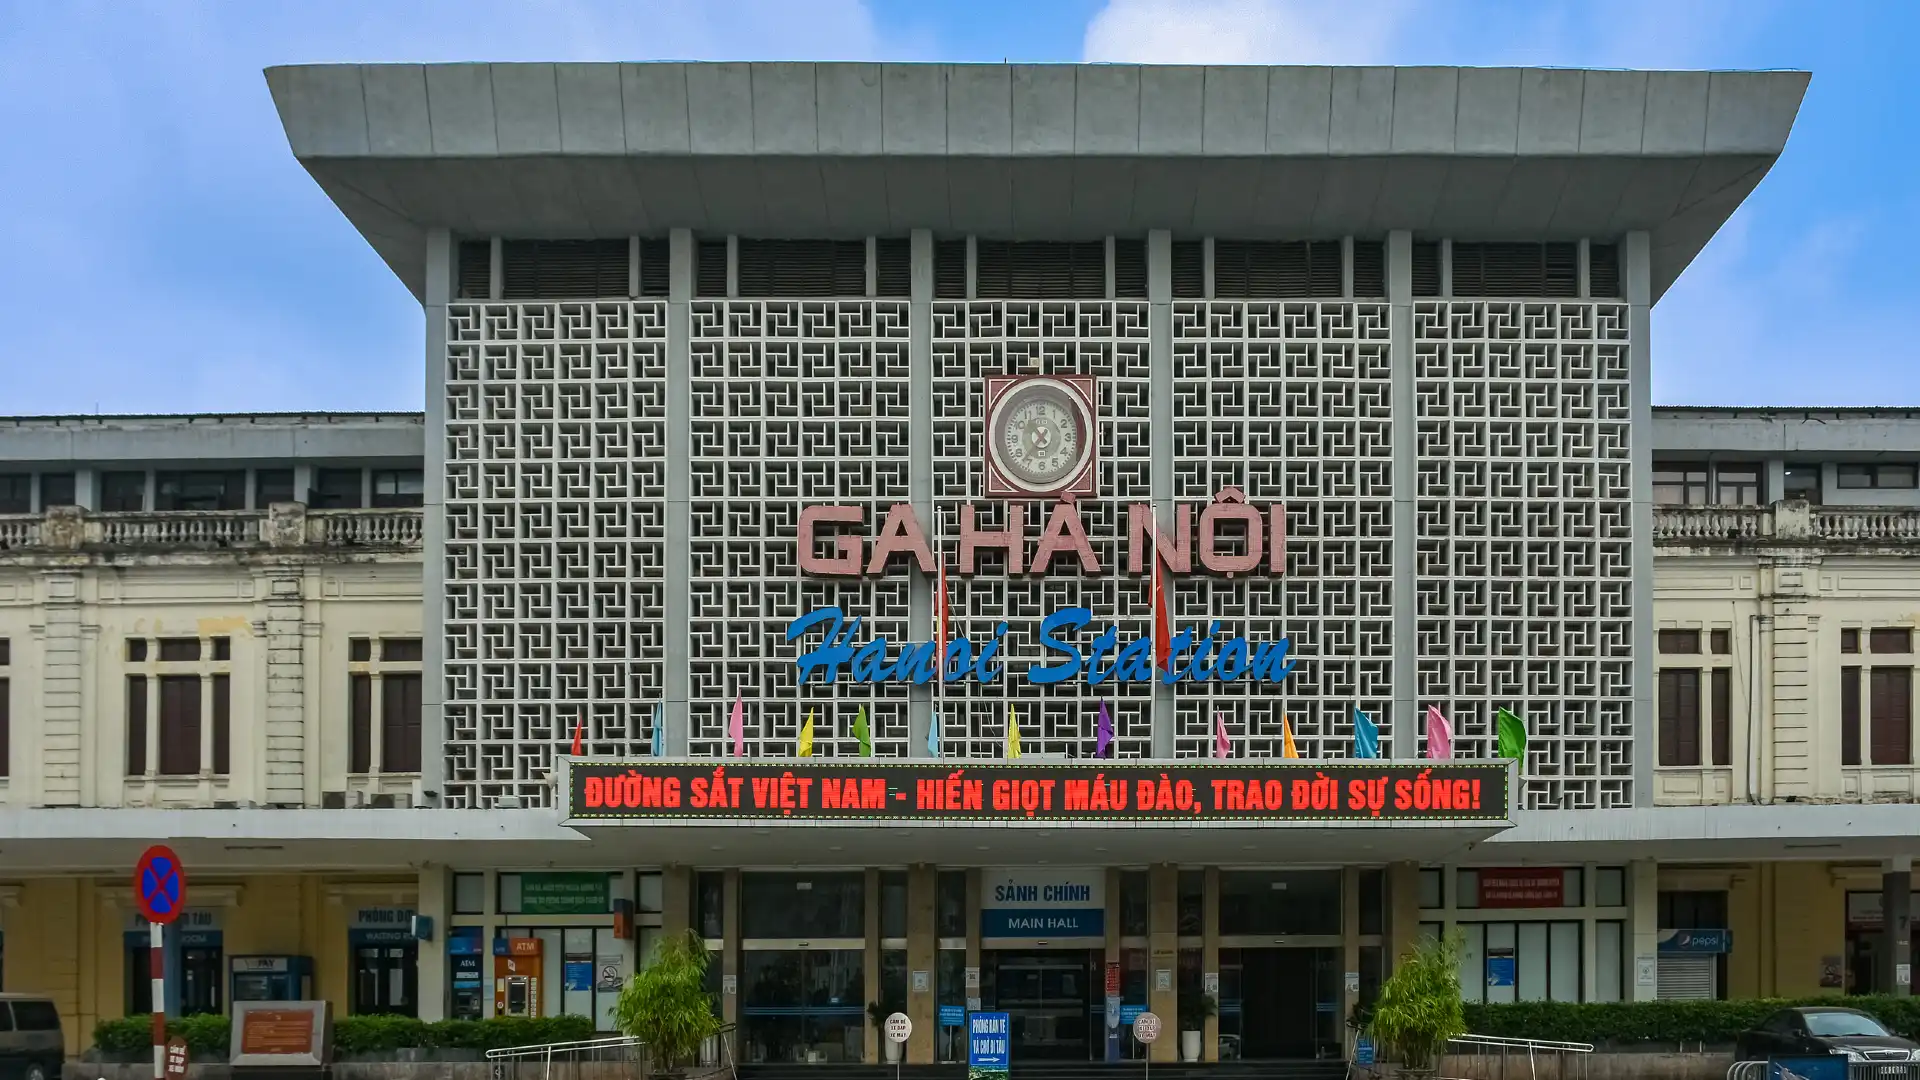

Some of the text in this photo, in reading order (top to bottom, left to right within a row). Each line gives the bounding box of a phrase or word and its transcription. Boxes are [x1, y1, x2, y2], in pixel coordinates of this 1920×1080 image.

[797, 486, 1286, 578] GA HÀ NỘI
[786, 606, 1297, 686] Hanoi Station
[584, 768, 681, 808] ĐƯỜNG
[690, 765, 744, 808] SẮT
[752, 771, 813, 815] VIỆT
[821, 778, 886, 809] NAM
[916, 769, 982, 811] HIẾN
[993, 778, 1056, 817] GIỌT
[1064, 772, 1128, 811] MÁU
[1136, 773, 1202, 815] ĐÀO,
[1211, 779, 1283, 811] TRAO
[1291, 771, 1339, 811] ĐỜI
[1348, 775, 1389, 817] SỰ
[1394, 768, 1481, 811] SỐNG!
[995, 879, 1090, 902] SẢNH CHÍNH
[1008, 917, 1079, 929] MAIN HALL
[516, 942, 535, 951] ATM
[1692, 935, 1719, 947] pepsi
[460, 959, 476, 968] ATM
